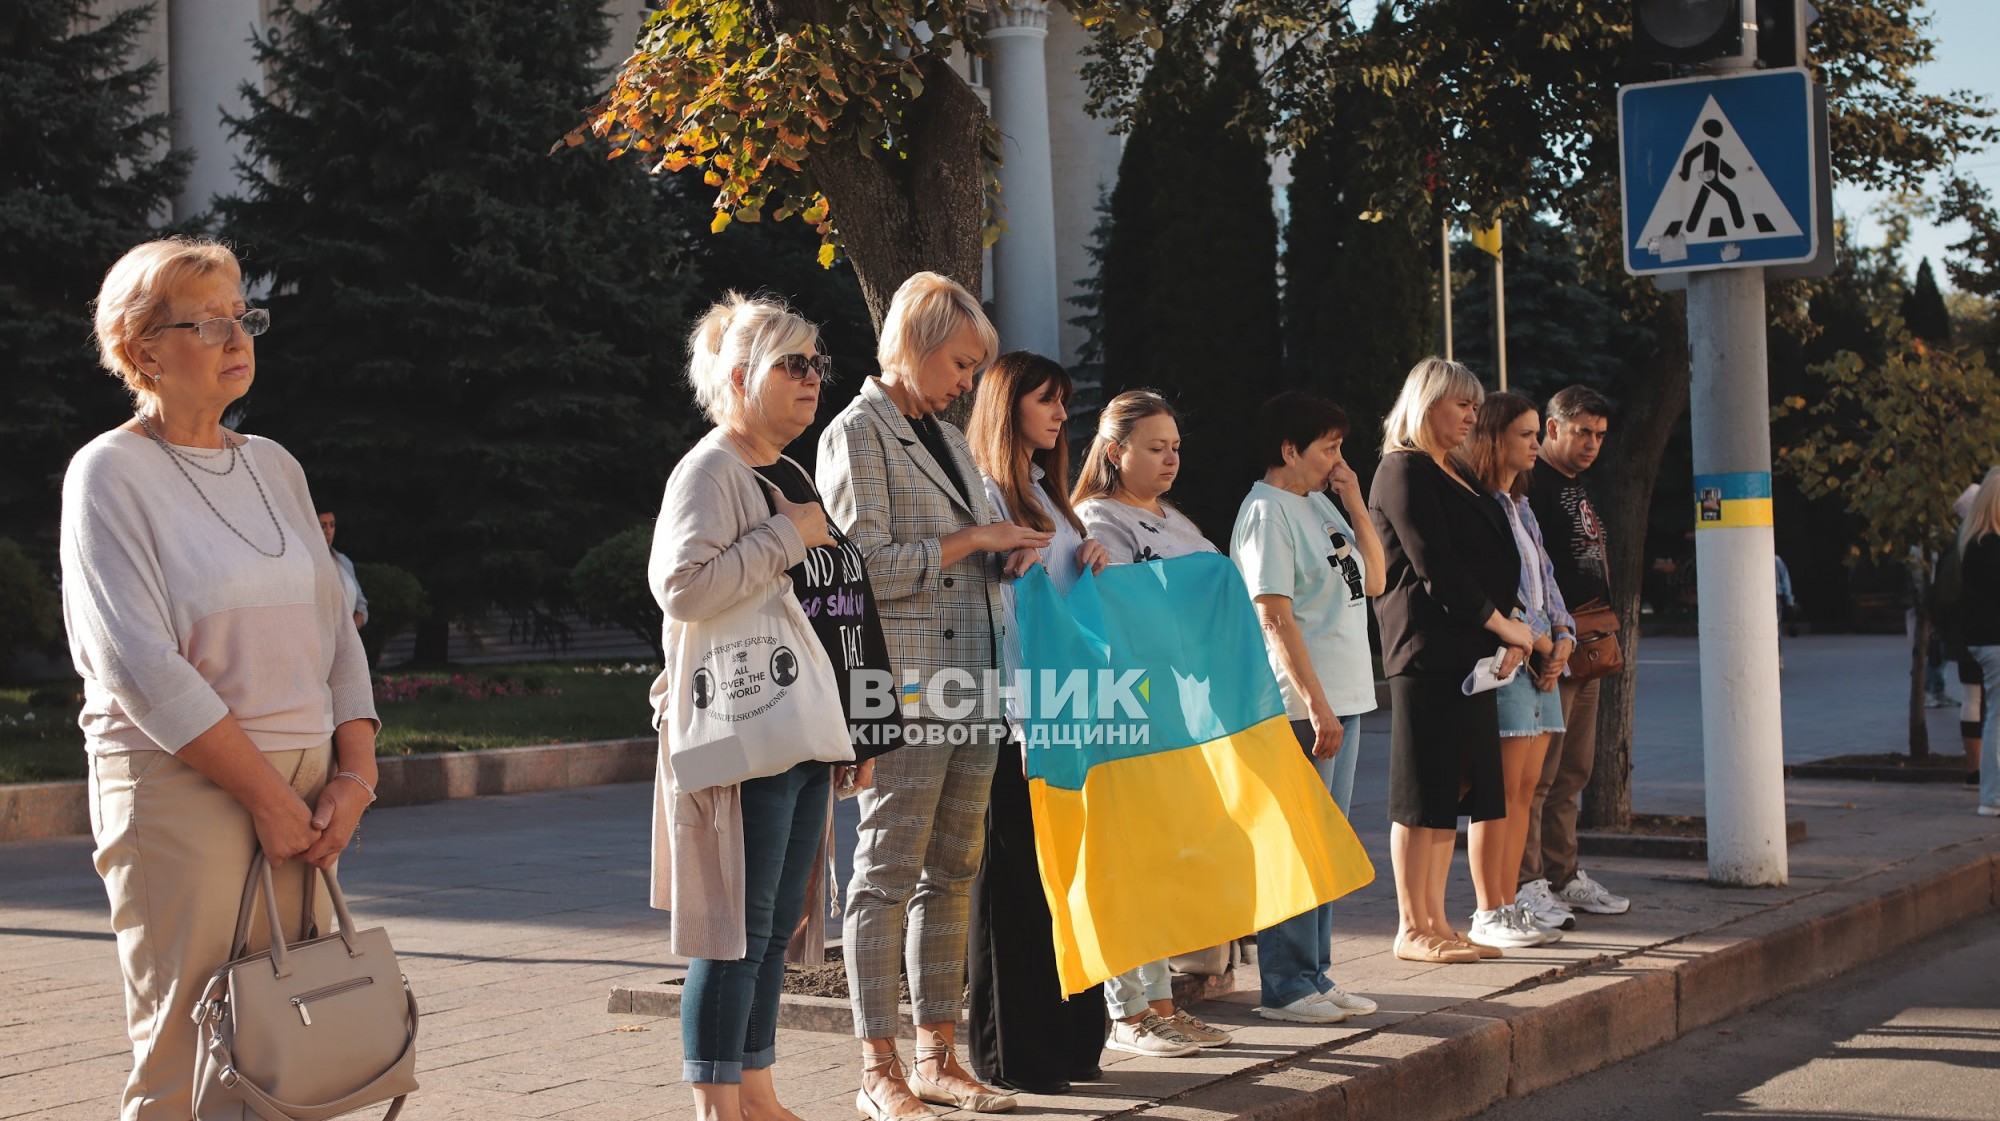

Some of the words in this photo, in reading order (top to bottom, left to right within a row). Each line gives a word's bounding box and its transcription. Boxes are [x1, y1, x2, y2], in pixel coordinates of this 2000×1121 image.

[744, 635, 778, 648] GRENES
[733, 665, 750, 676] ALL
[720, 677, 745, 691] OVER
[747, 671, 766, 684] THE
[726, 684, 761, 700] WORLD
